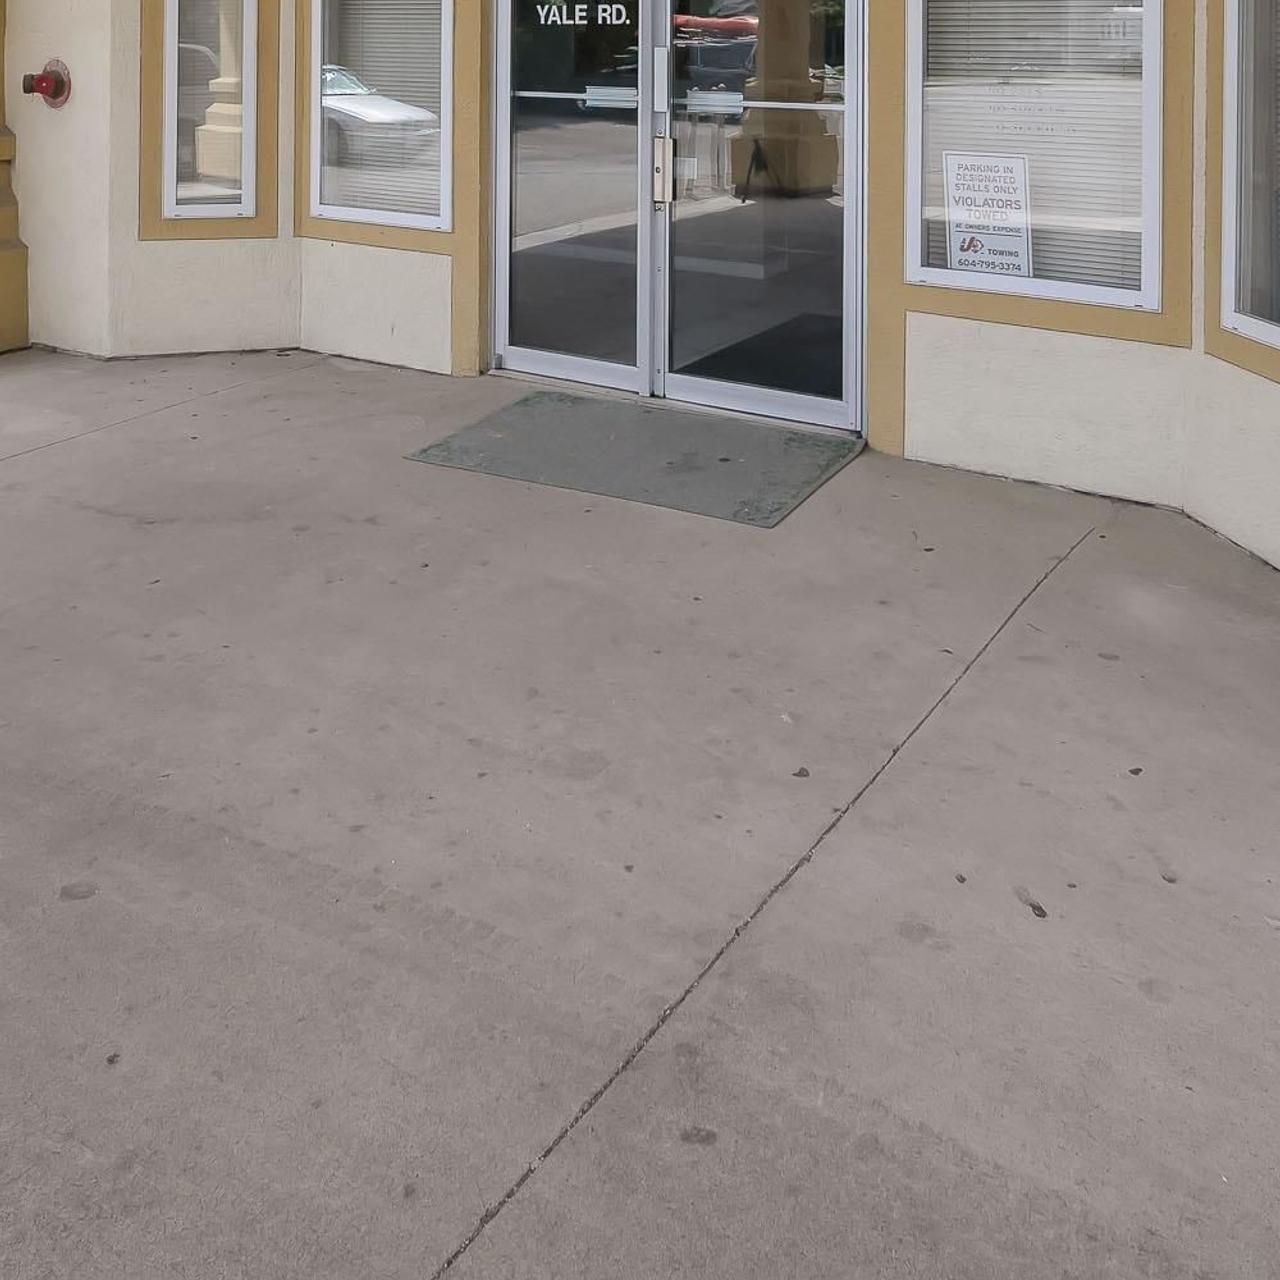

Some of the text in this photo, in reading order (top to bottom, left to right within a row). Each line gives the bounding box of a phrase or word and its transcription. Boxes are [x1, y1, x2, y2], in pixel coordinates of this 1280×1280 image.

[536, 3, 631, 26] YALE RD.
[957, 163, 1014, 174] PARKING IN
[956, 173, 1016, 185] DESIGNATED
[954, 183, 1019, 195] STALLS ONLY
[952, 195, 1022, 210] VIOLATORS
[965, 208, 1009, 221] TOWED
[987, 248, 1019, 258] TOWING
